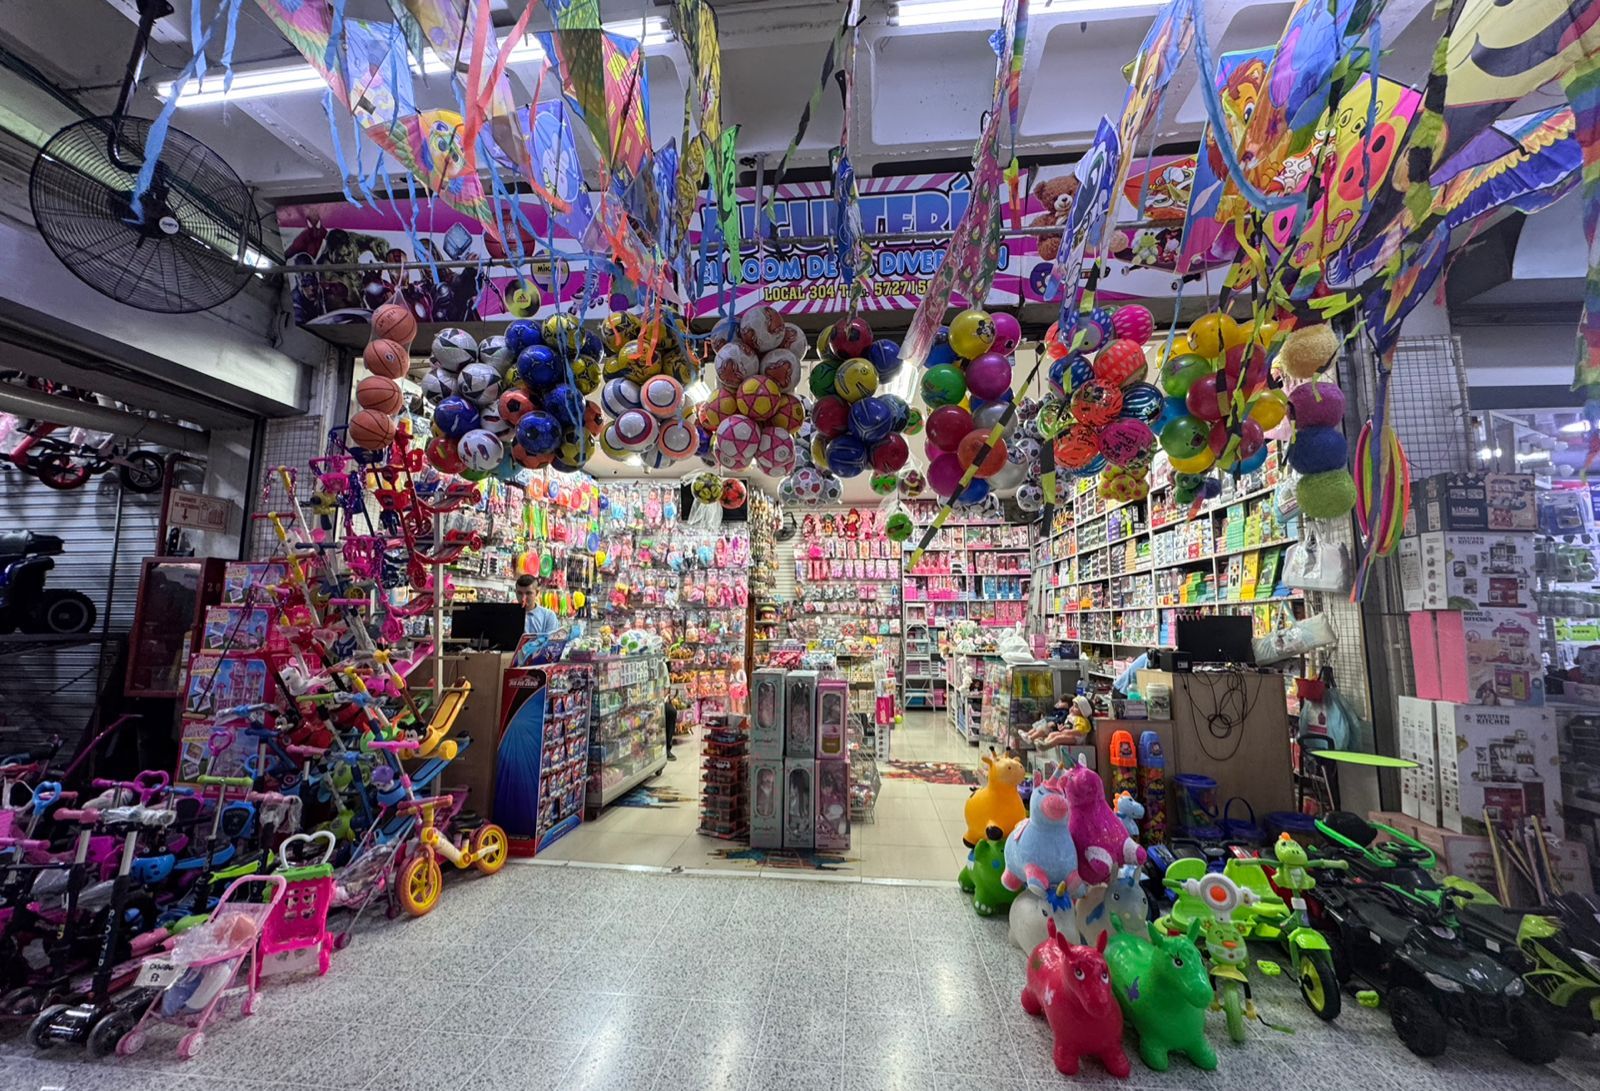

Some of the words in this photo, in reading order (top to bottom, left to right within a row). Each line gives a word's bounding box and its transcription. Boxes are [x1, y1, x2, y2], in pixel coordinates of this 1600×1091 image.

[806, 254, 839, 278] DE
[764, 285, 806, 301] LOCAL
[809, 284, 835, 300] 304
[98, 909, 115, 967] SCOOTER
